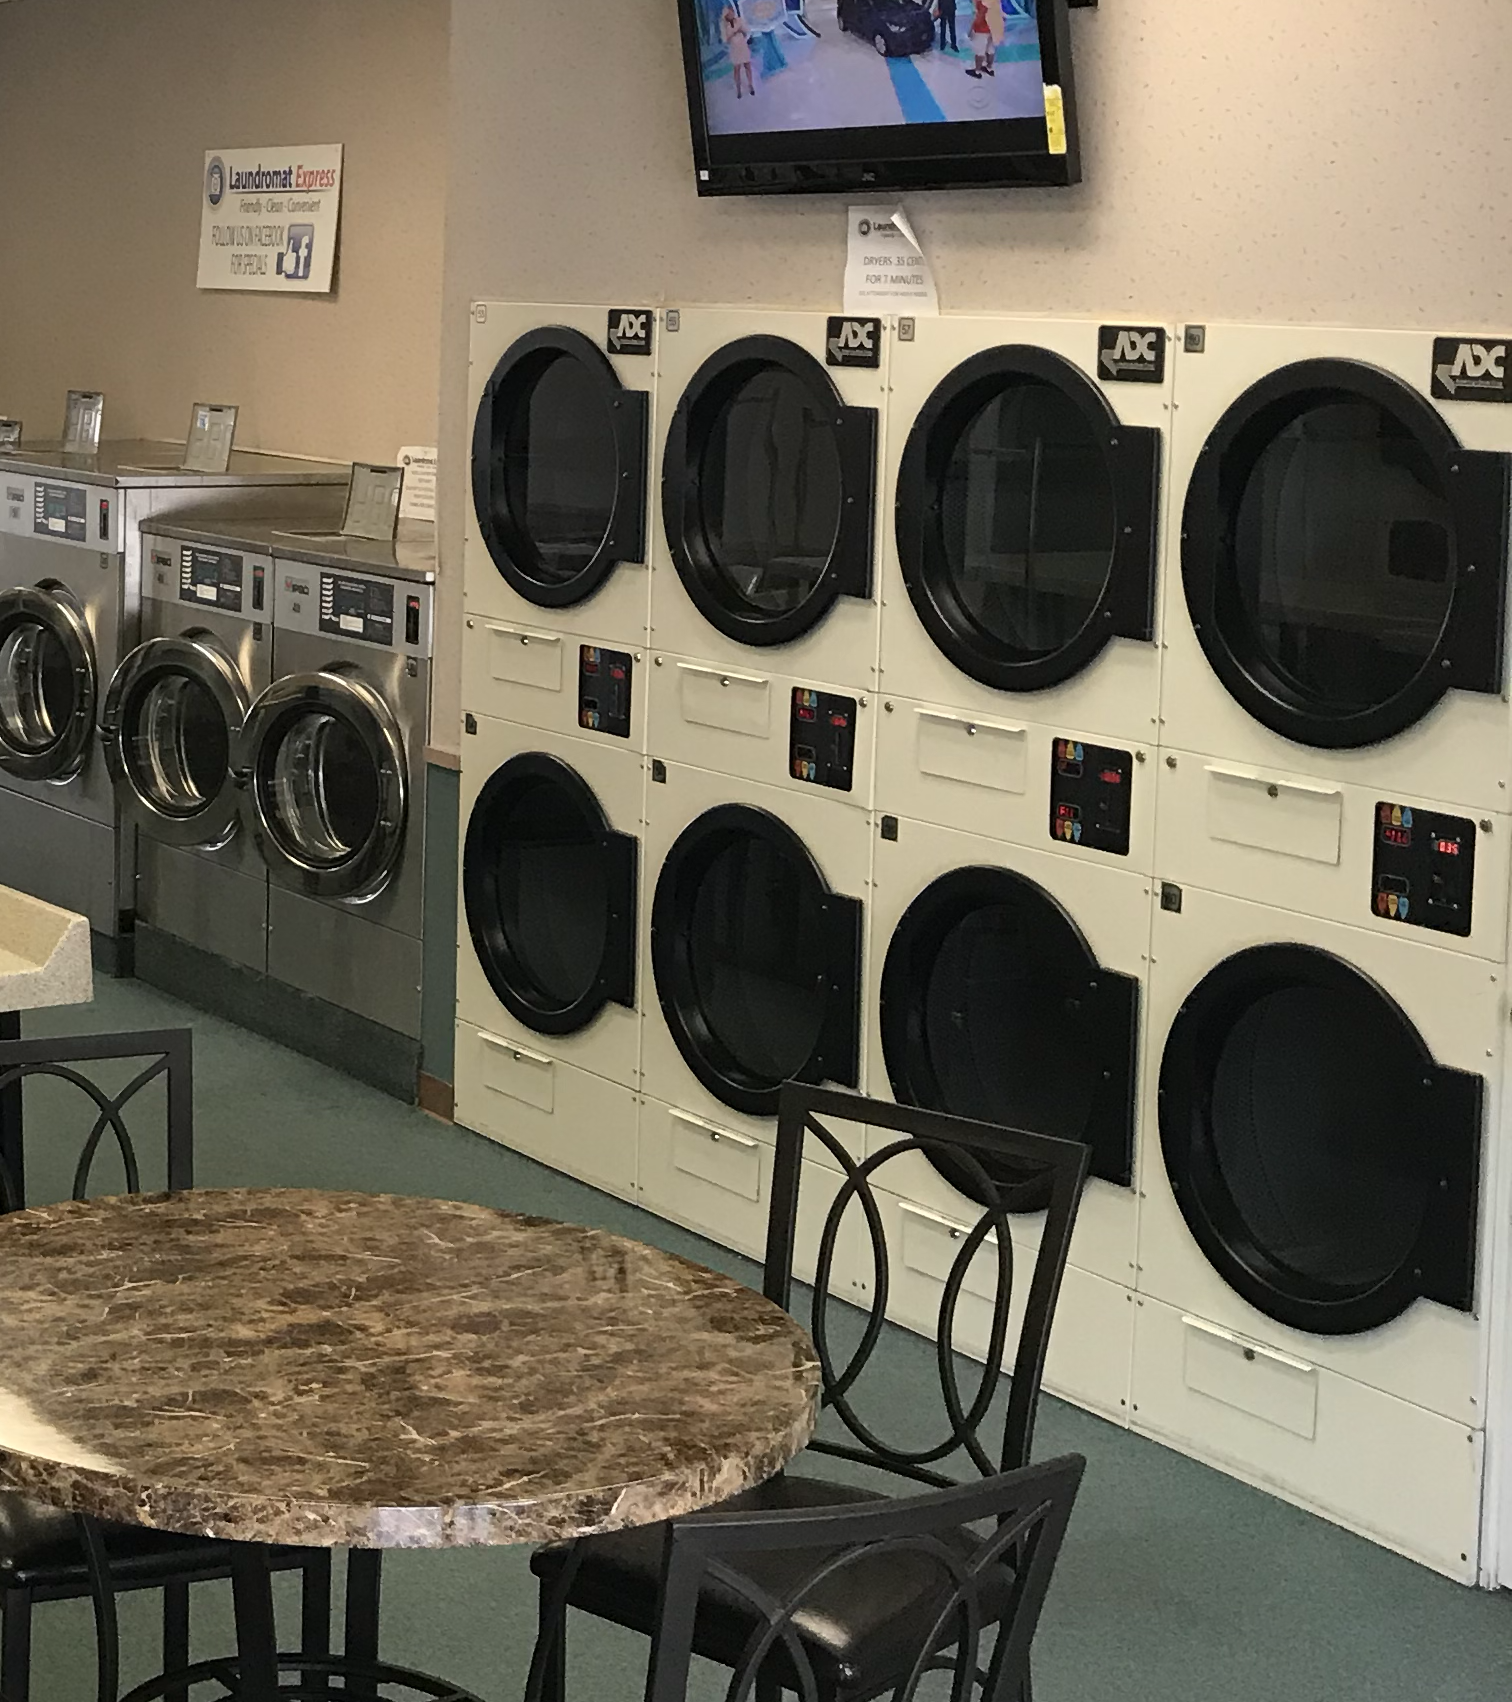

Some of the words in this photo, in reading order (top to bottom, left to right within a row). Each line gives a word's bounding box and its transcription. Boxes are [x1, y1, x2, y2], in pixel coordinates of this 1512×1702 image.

[229, 163, 293, 190] Laundromat
[295, 165, 336, 193] Express
[212, 225, 235, 247] FOLLOW
[255, 225, 284, 247] FACEBOOK
[864, 256, 892, 266] DRYERS
[866, 274, 881, 285] FOR
[891, 274, 924, 285] MINUTES
[617, 314, 646, 337] ADC
[838, 321, 874, 348] ADC
[1113, 330, 1157, 361] ADC
[1451, 344, 1506, 378] ADC
